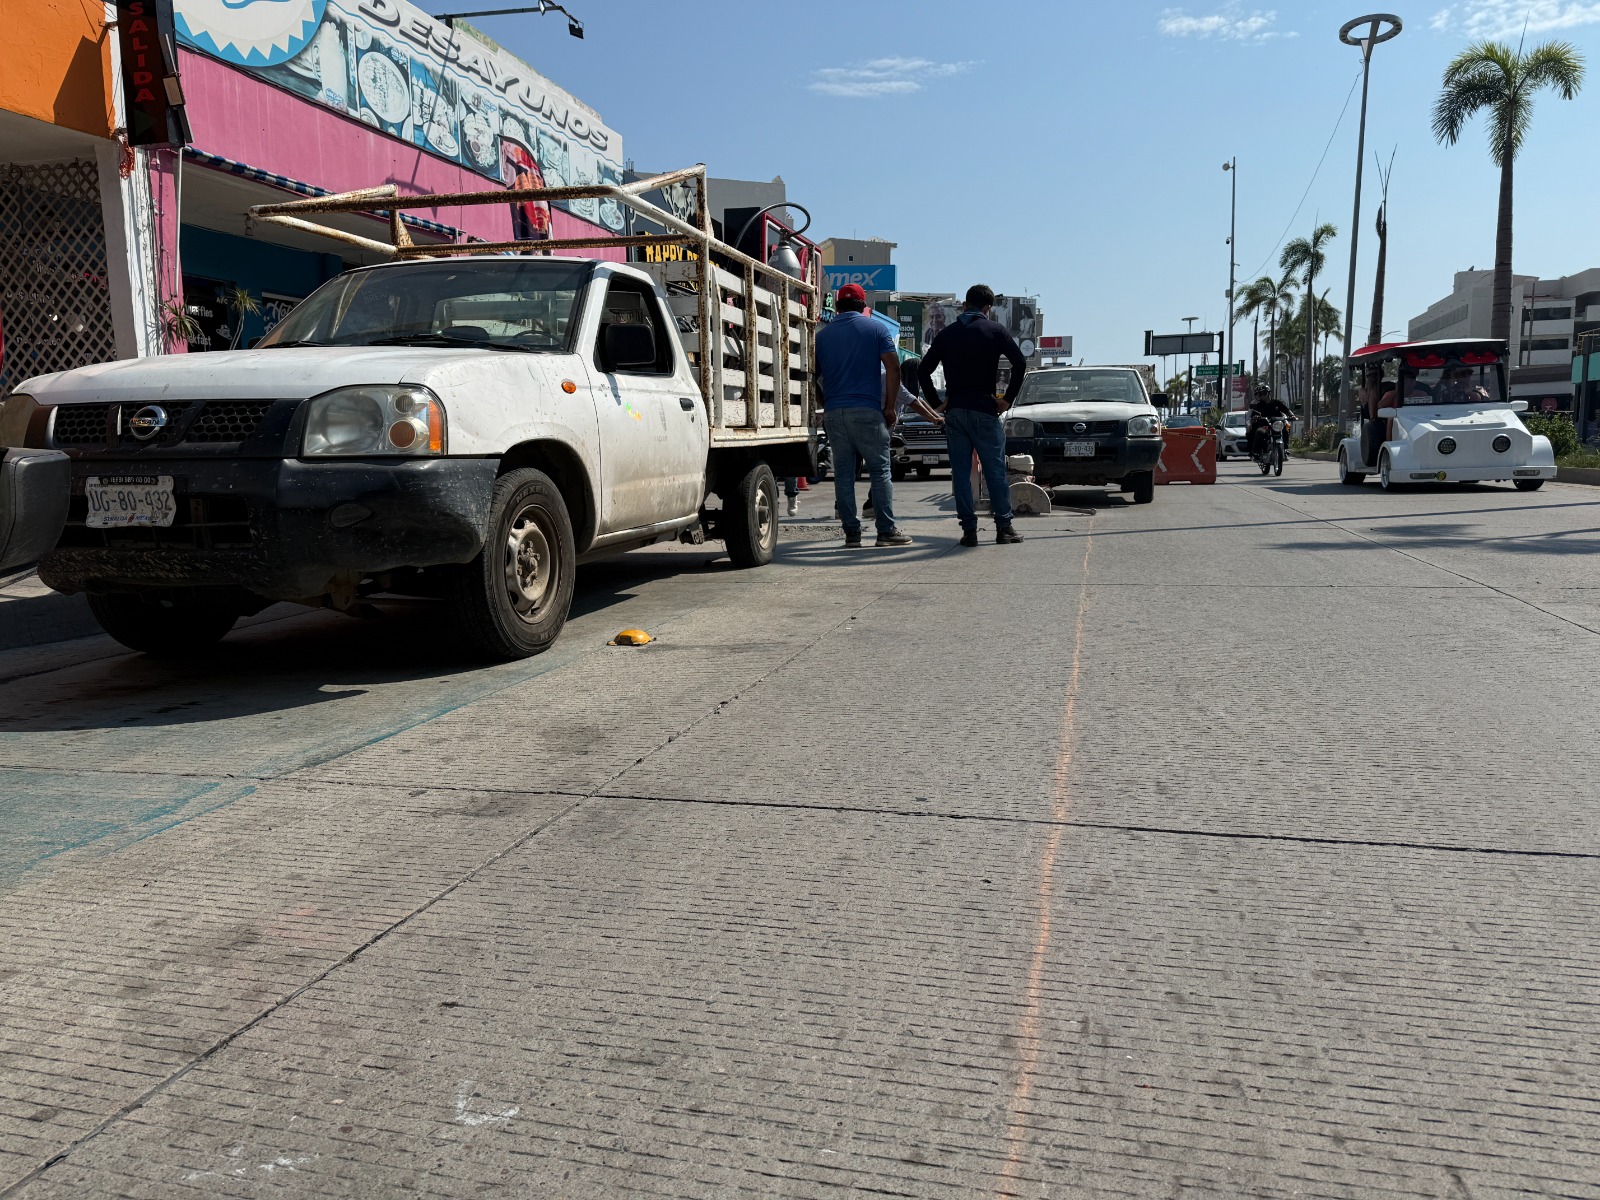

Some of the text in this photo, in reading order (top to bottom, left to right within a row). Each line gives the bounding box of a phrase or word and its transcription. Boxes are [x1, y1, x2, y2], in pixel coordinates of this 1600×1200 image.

[129, 2, 155, 102] SALIDA
[357, 0, 610, 151] DESAYUNOS
[829, 267, 883, 286] mex
[185, 305, 214, 318] Waffles
